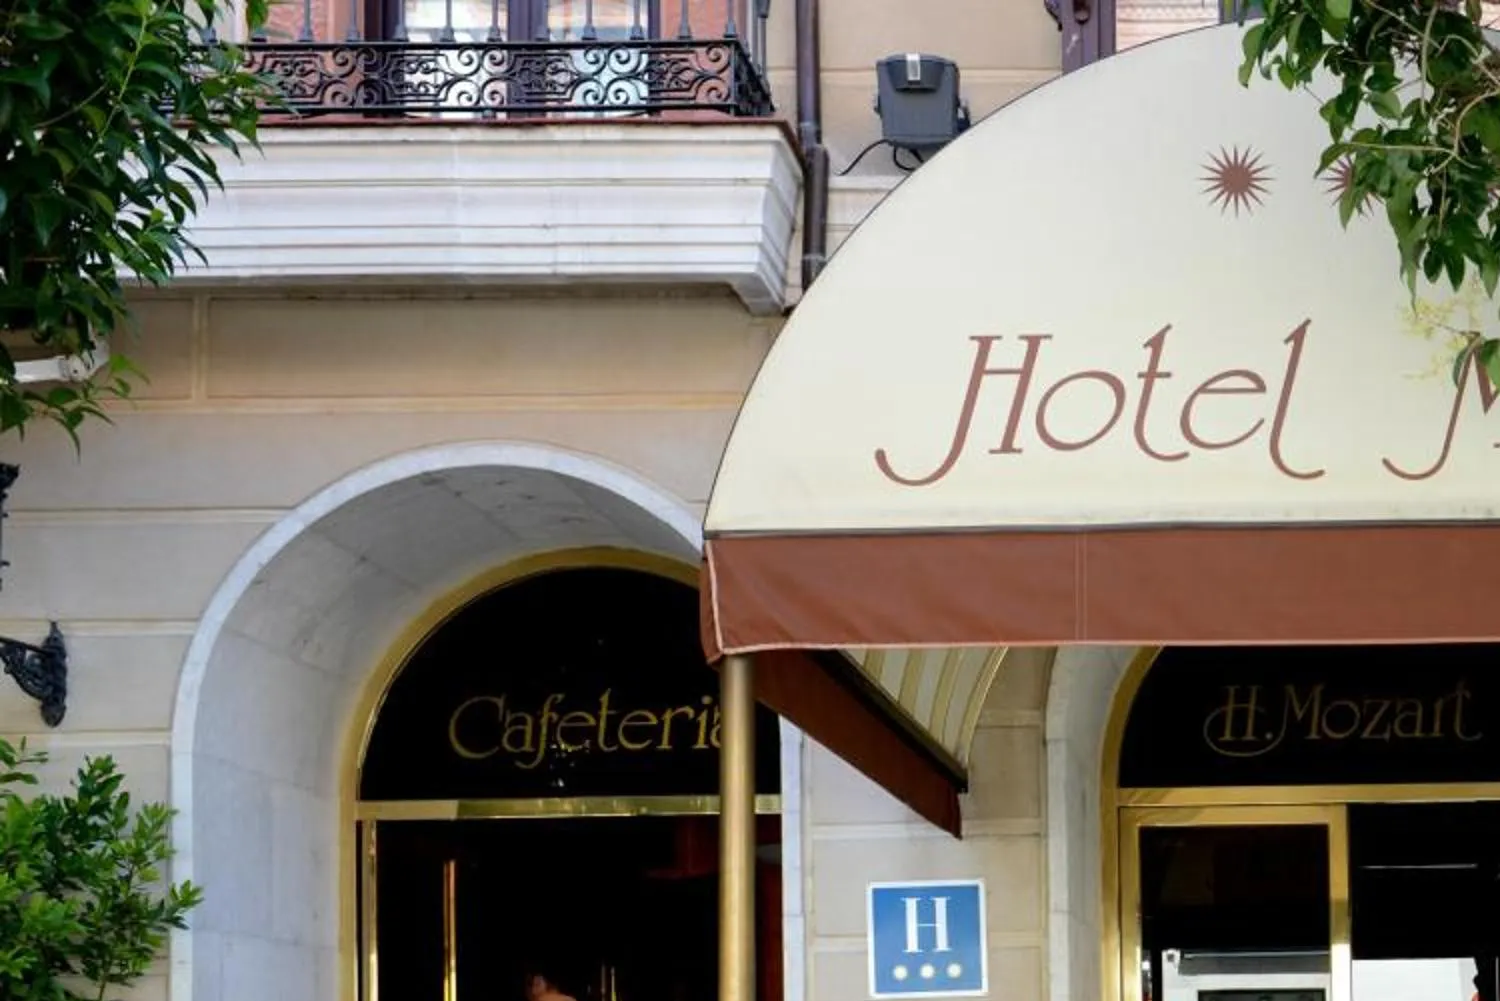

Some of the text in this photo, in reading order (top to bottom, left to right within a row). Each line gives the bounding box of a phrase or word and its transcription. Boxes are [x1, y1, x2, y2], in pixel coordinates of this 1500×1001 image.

[874, 317, 1326, 487] Hotel
[1282, 676, 1484, 744] Mozart
[900, 895, 953, 954] H
